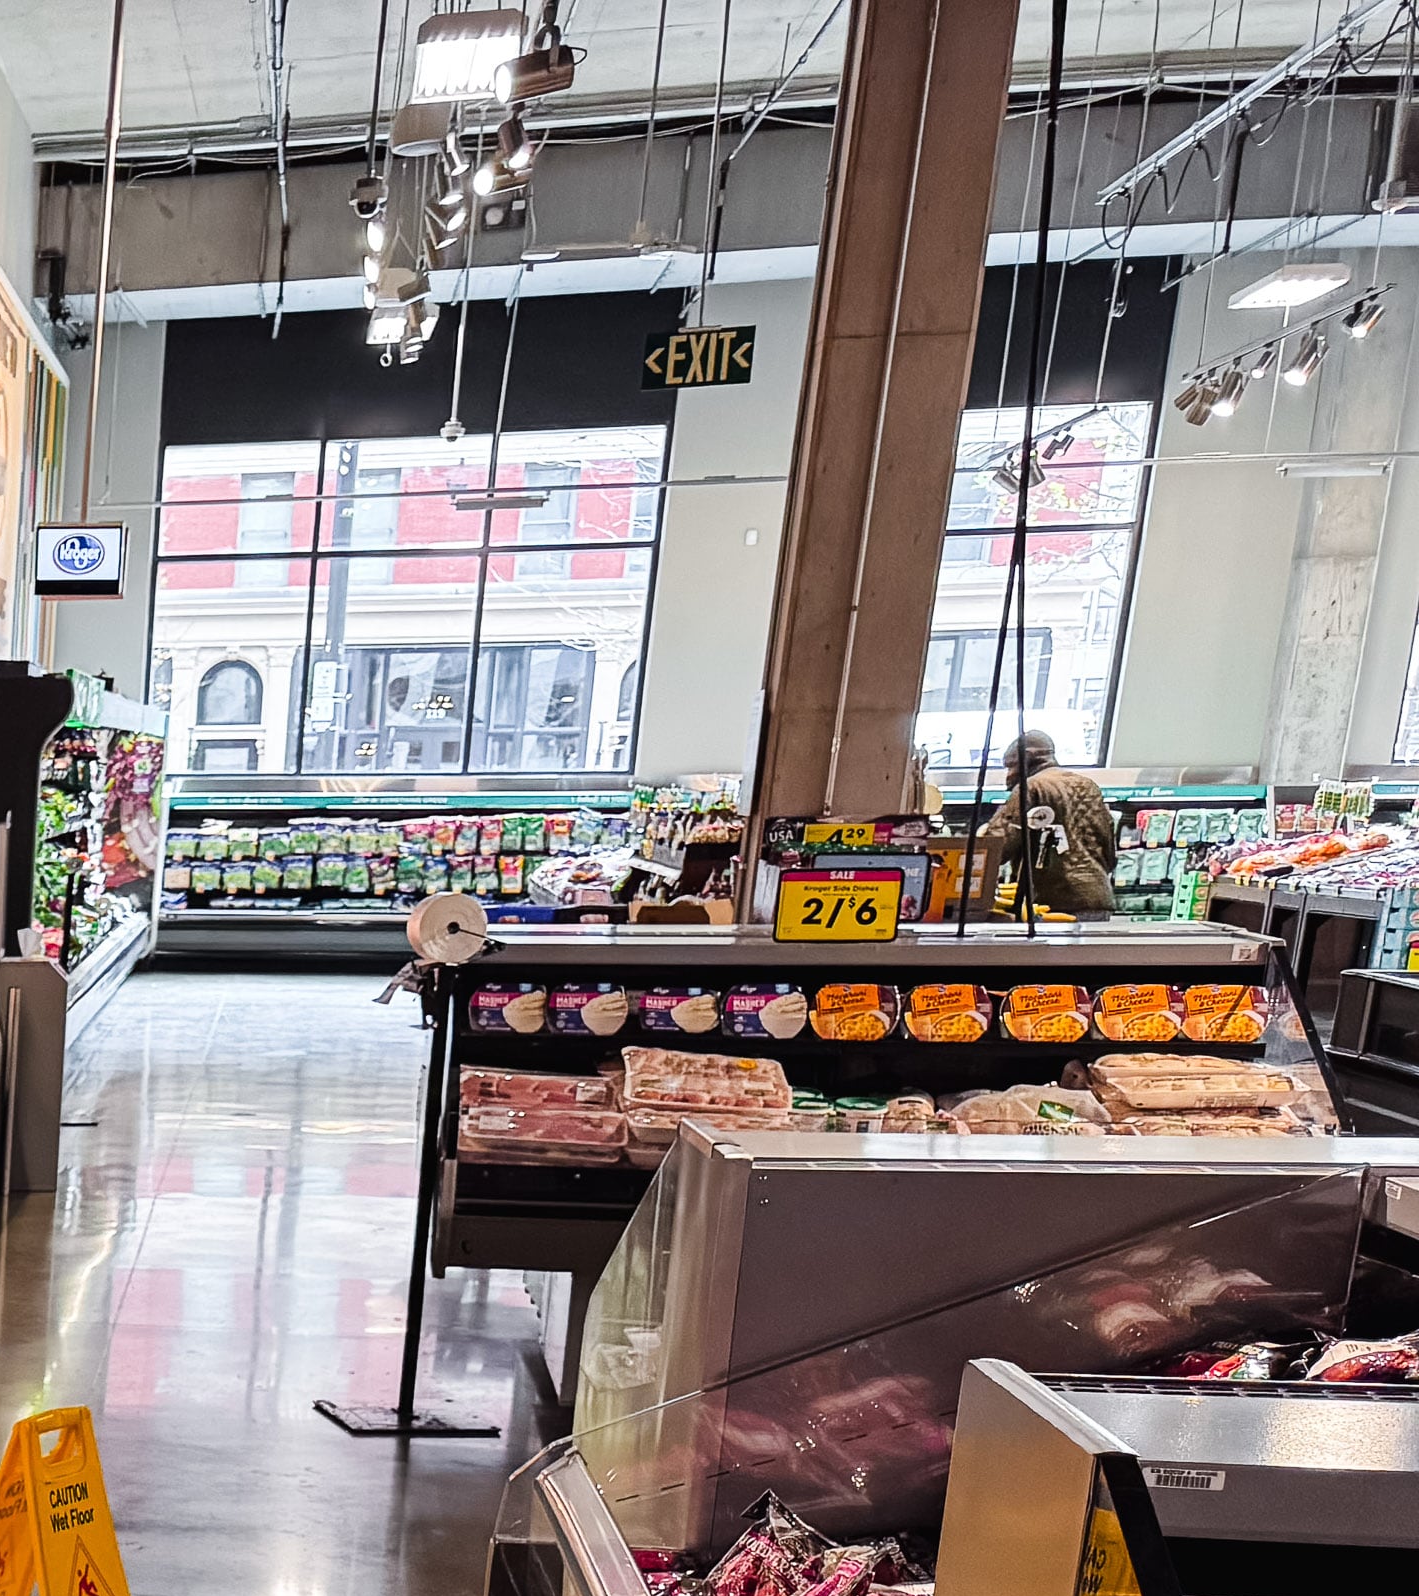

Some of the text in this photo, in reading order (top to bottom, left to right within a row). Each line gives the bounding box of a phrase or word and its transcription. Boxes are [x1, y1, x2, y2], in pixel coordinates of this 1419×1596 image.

[665, 331, 738, 385] EXIT
[59, 538, 101, 570] Kroger
[768, 828, 795, 843] USA
[828, 870, 856, 881] SALE
[800, 896, 878, 929] 2/$6
[48, 1481, 89, 1509] CAUTION
[50, 1506, 95, 1533] Wet Floor
